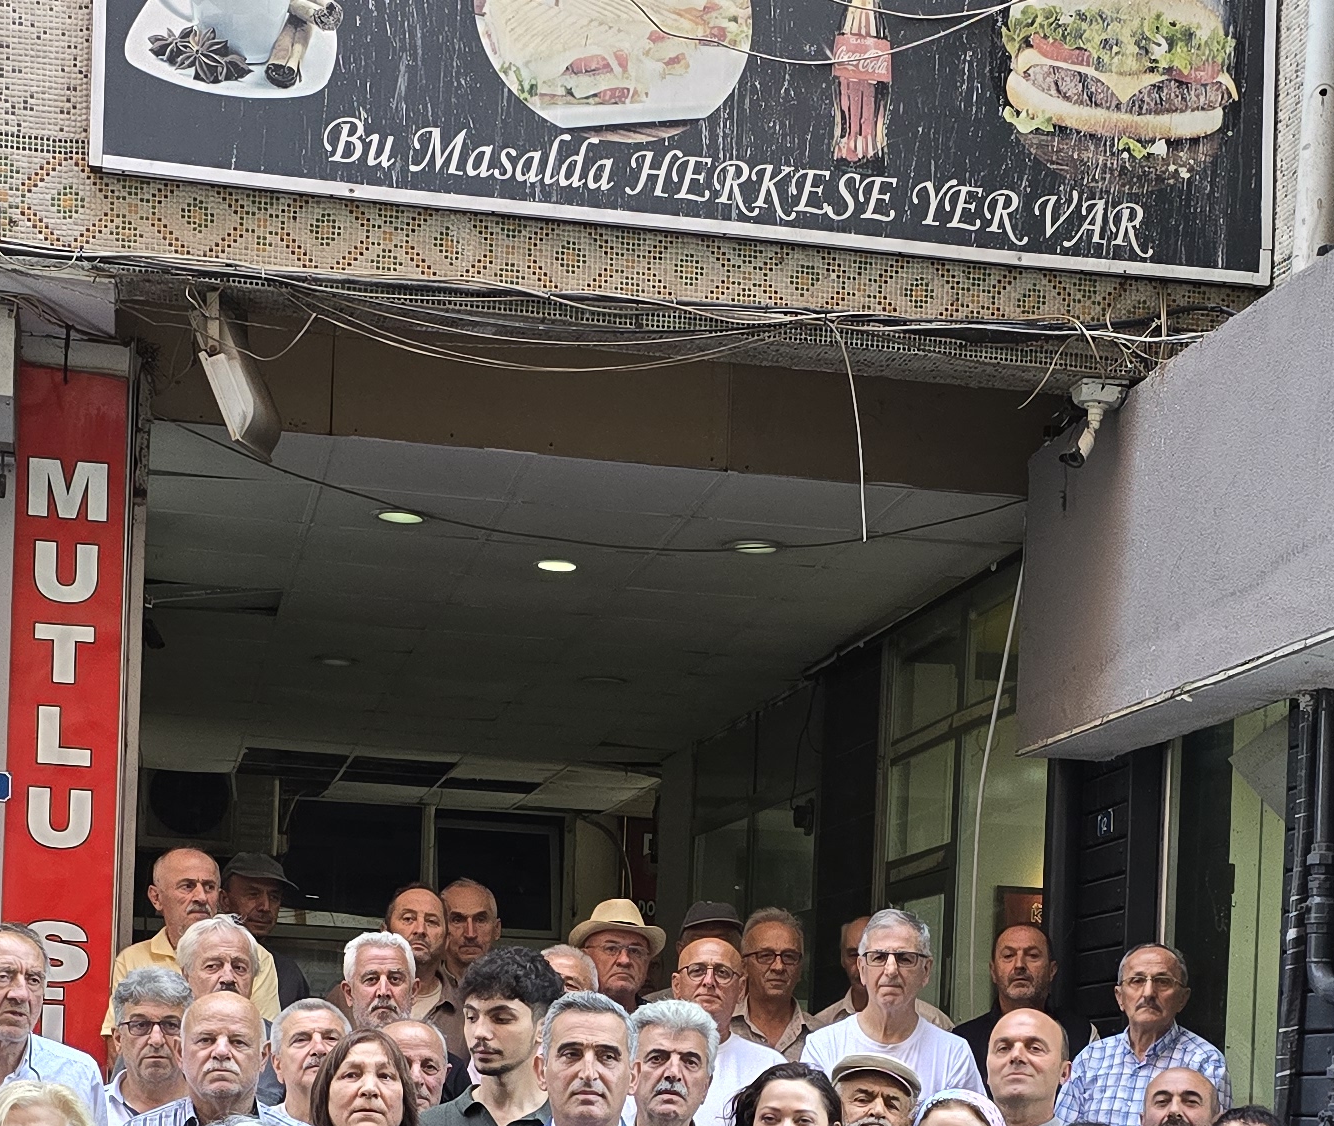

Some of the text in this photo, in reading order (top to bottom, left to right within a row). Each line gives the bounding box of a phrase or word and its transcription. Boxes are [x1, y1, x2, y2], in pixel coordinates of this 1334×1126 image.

[323, 117, 1154, 258] Bu Masalda HERKESE YER VAR
[27, 456, 109, 850] MUTLU
